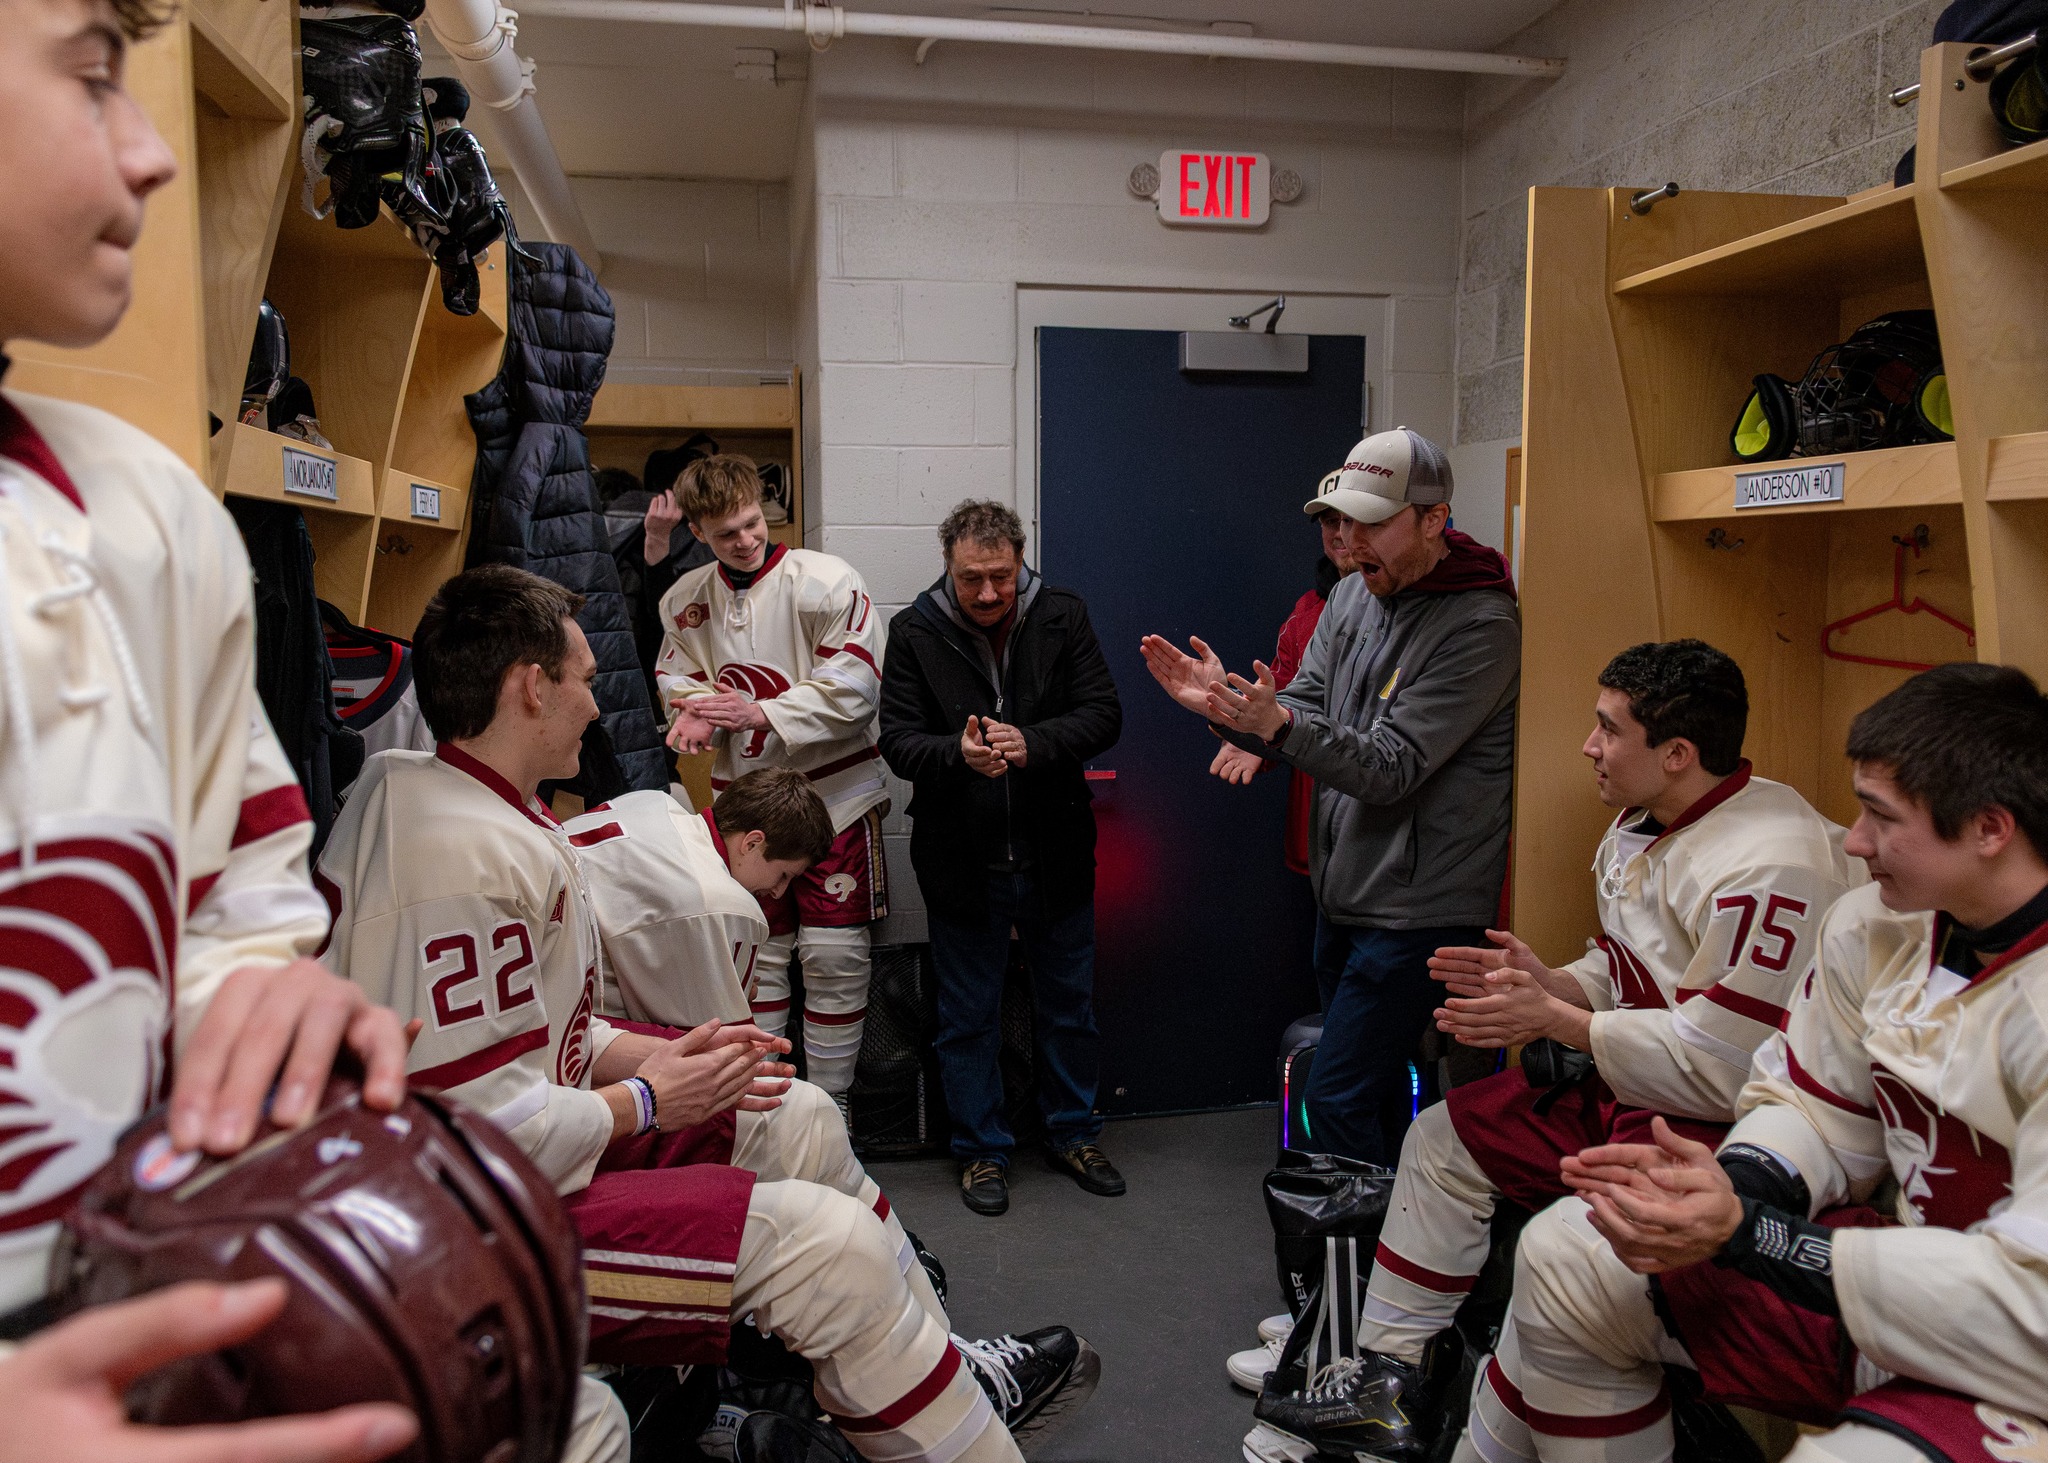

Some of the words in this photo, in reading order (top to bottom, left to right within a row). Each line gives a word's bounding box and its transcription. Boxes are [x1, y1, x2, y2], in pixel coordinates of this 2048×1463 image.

[1180, 154, 1256, 219] EXIT
[1747, 472, 1810, 503] ANDERSON
[1814, 469, 1833, 496] #10
[1715, 892, 1809, 973] 75
[422, 920, 537, 1029] 22
